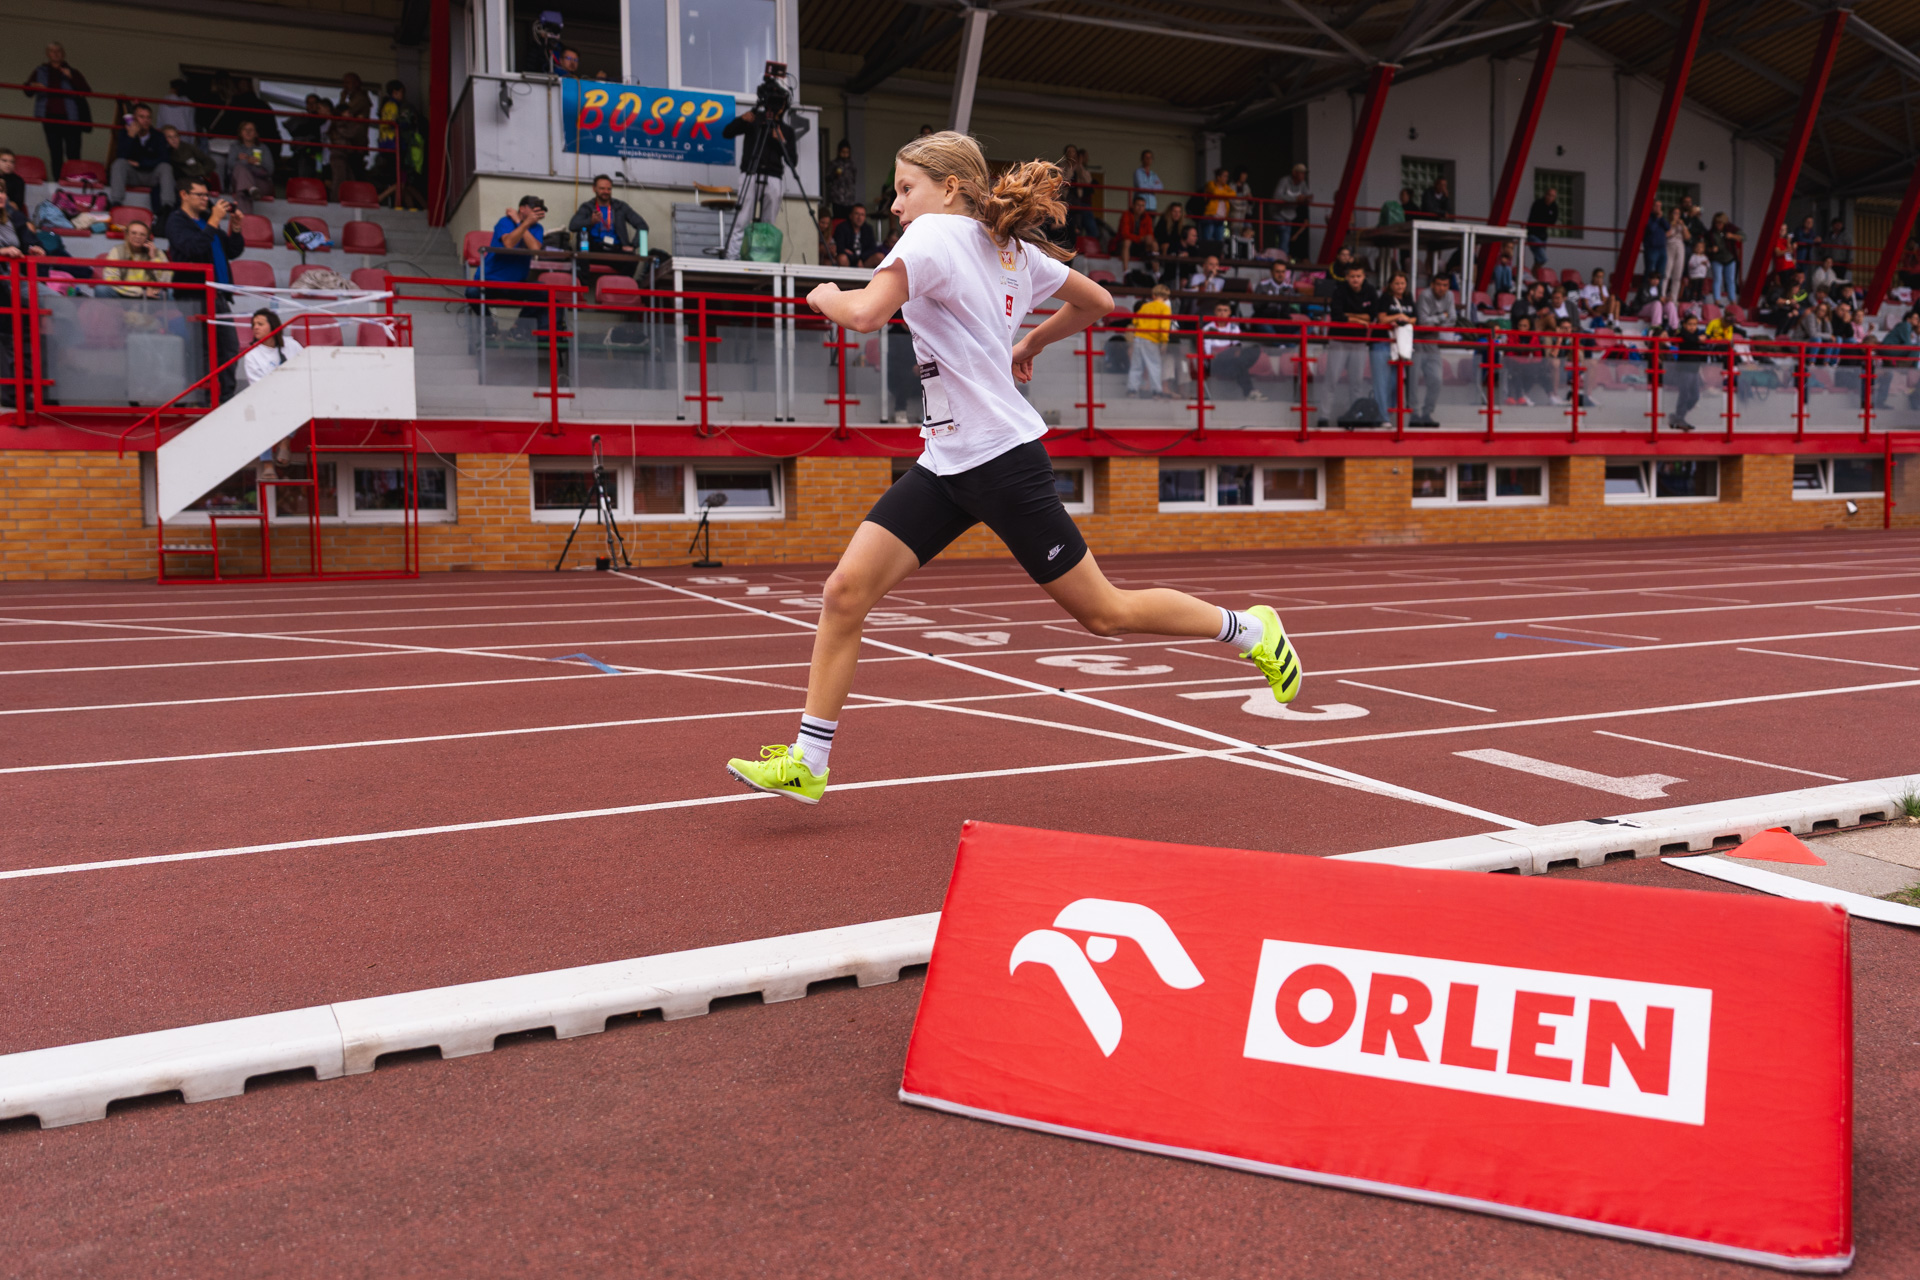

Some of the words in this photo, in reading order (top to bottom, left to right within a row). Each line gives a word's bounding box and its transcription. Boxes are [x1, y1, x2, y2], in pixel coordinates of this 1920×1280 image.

[577, 88, 723, 140] BOSiR
[596, 134, 704, 152] BIAŁYSTOK
[1035, 654, 1174, 676] 3
[1176, 687, 1370, 721] 2
[1451, 748, 1689, 800] 1
[1274, 963, 1675, 1097] ORLEN
